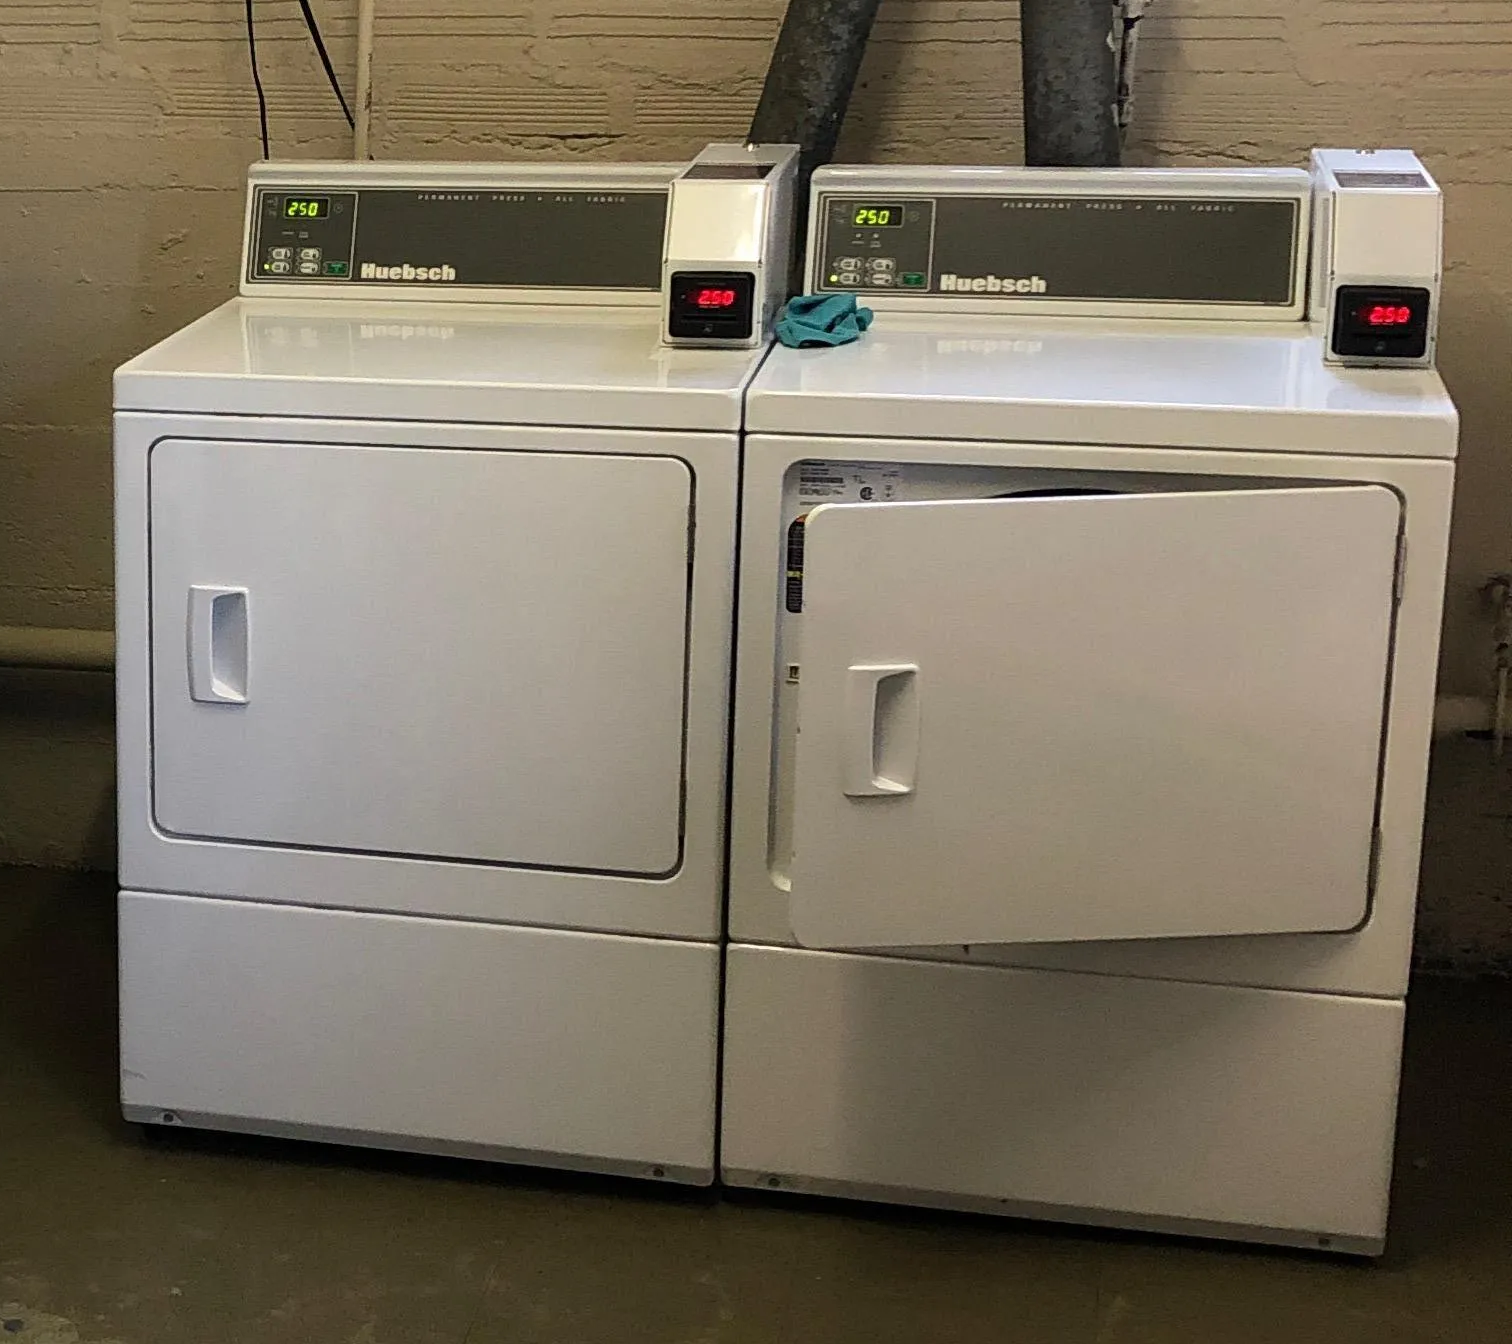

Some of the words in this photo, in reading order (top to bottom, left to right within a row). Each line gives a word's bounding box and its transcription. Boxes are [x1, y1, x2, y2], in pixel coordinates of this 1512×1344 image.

[287, 202, 320, 217] 250
[855, 209, 891, 225] 250
[360, 262, 457, 281] Huebsch
[940, 273, 1047, 293] Huebsch
[697, 289, 735, 306] 250
[1369, 305, 1411, 324] 250
